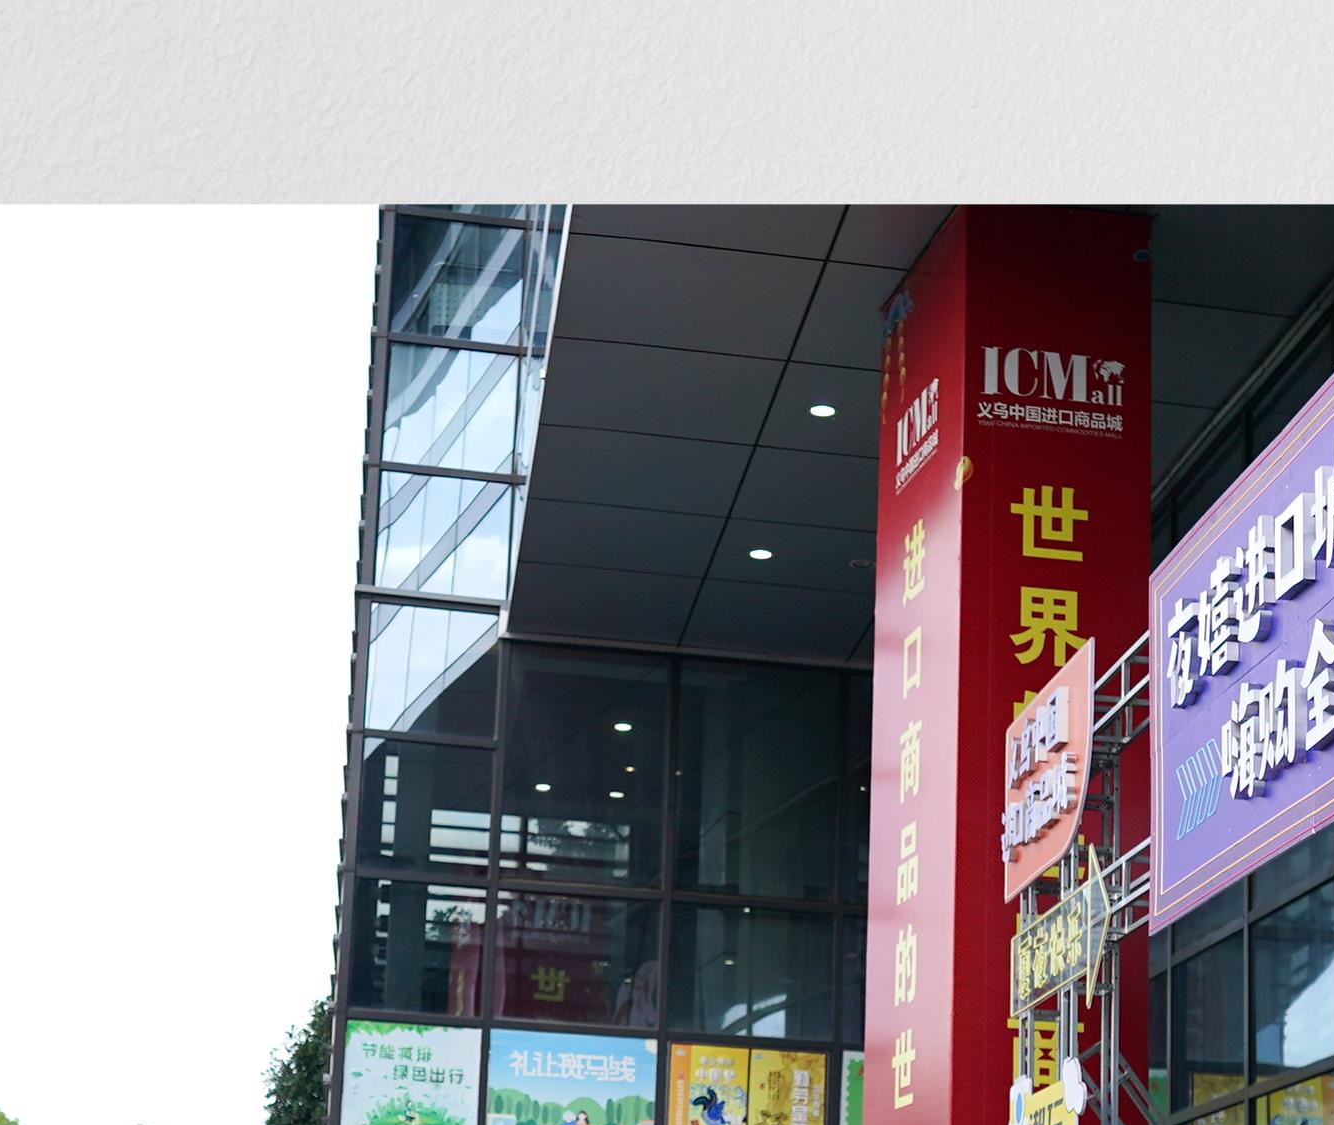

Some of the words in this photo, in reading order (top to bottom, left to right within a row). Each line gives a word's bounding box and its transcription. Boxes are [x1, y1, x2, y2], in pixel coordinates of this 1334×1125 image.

[981, 346, 1123, 406] ICMall
[977, 402, 1123, 432] 义乌中国进口商品城
[361, 1043, 432, 1062] 节能减排
[509, 1050, 637, 1083] 礼让斑马线
[392, 1065, 465, 1084] 绿色出行
